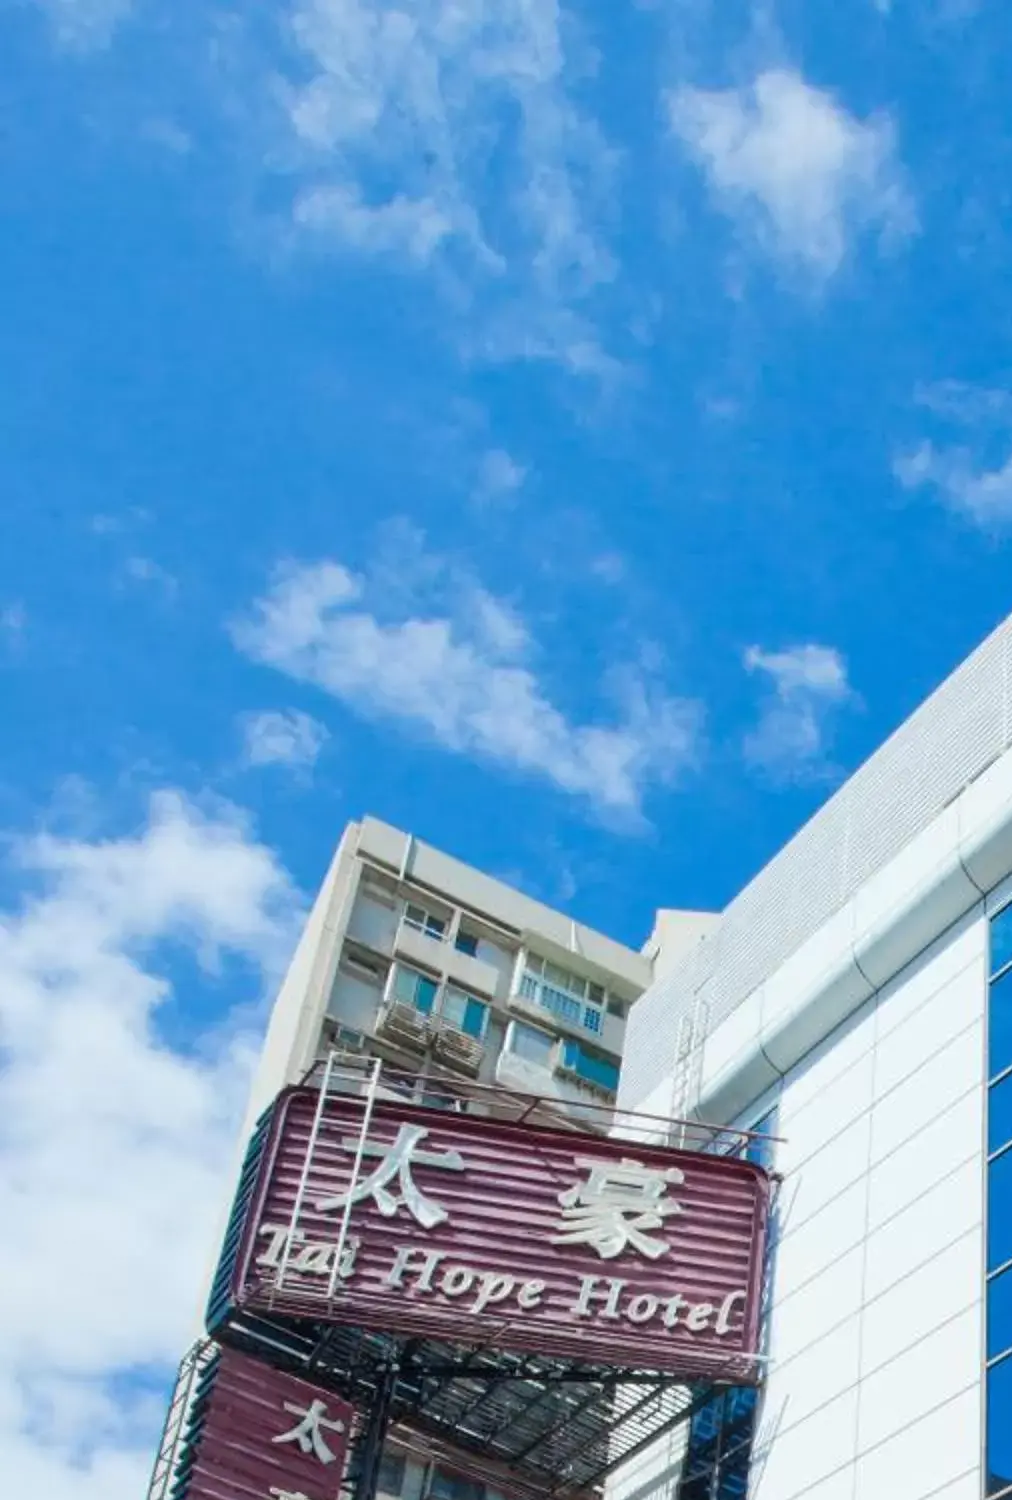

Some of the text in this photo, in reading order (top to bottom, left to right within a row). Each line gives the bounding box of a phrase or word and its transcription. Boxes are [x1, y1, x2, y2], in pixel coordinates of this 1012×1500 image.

[314, 1122, 685, 1260] 太豪
[254, 1222, 748, 1336] Tai Hope Hotel
